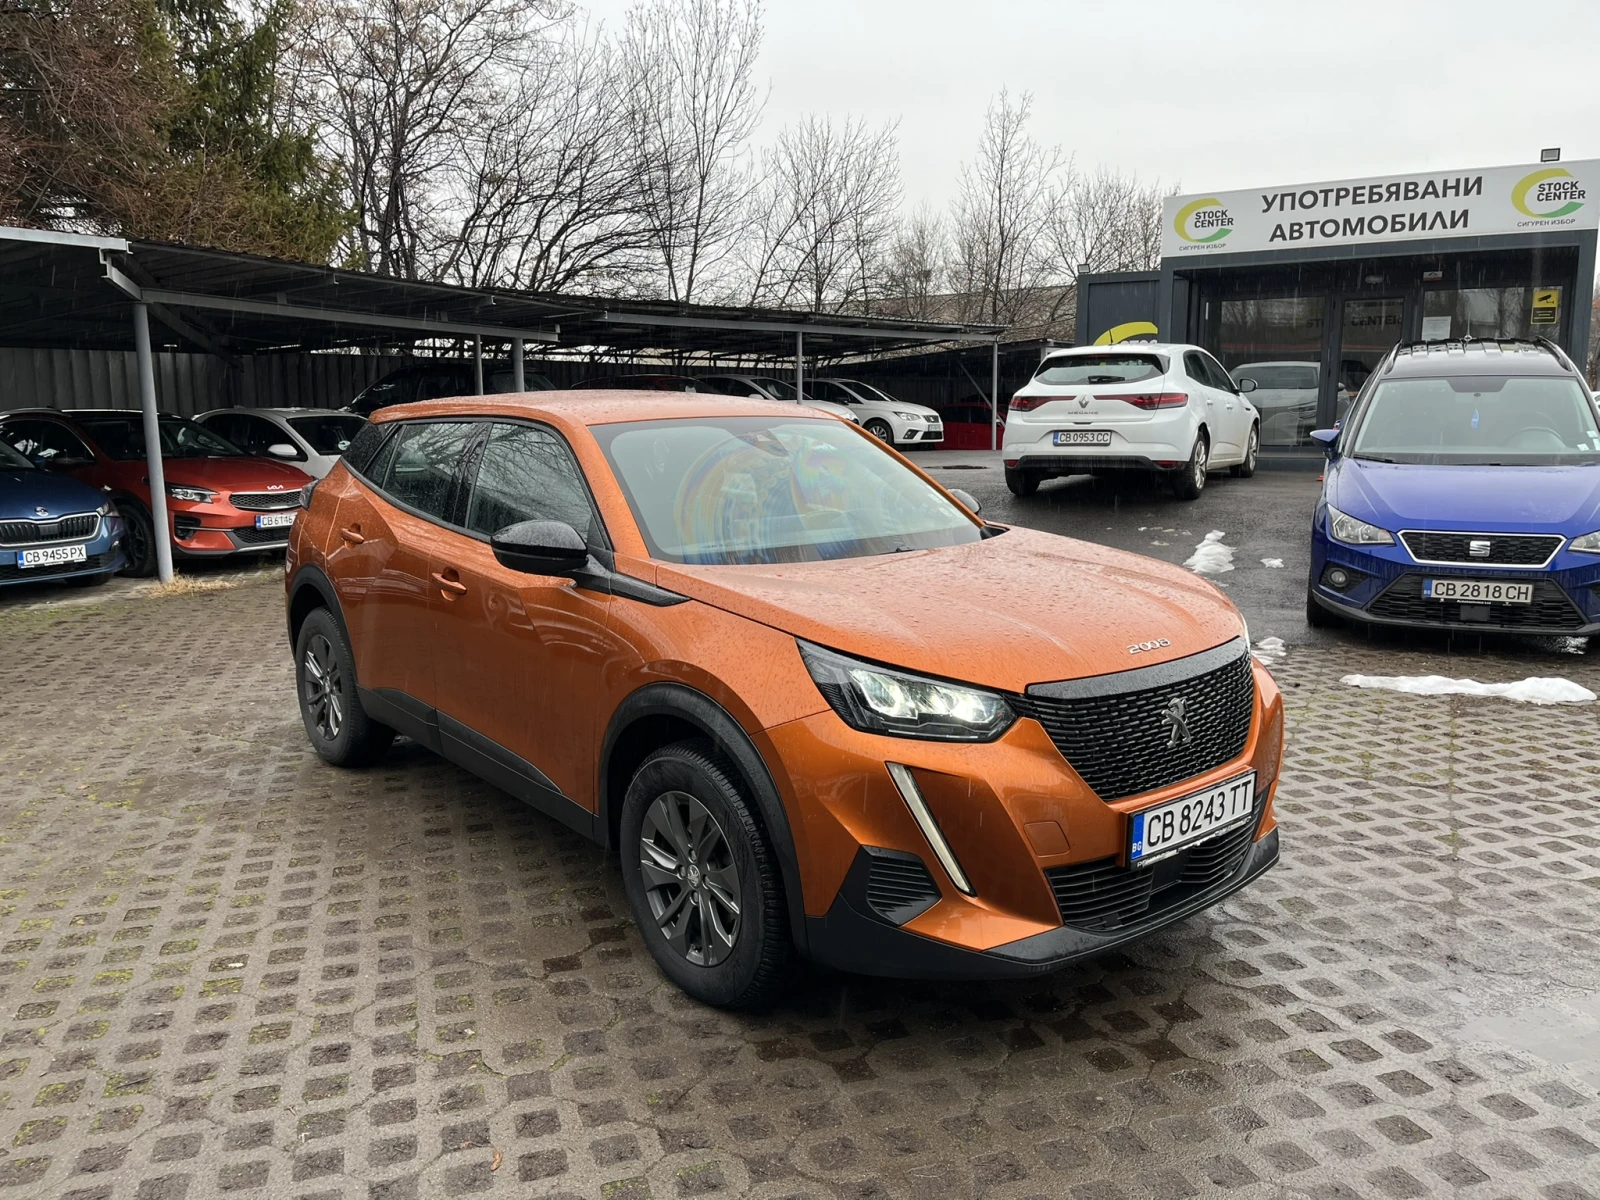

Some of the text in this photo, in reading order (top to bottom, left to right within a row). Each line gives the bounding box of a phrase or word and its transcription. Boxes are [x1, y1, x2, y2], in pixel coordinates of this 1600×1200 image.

[1538, 180, 1579, 193] STOCK
[1261, 176, 1483, 214] УПОТРЕБЯВАНИ
[1536, 189, 1586, 202] CENTER
[1195, 209, 1229, 220] STOCK
[1194, 217, 1234, 229] CENTER
[1268, 209, 1470, 242] АВТОМОБИЛИ
[1517, 218, 1576, 227] СИГУРЕН ИЗБОР
[1059, 432, 1109, 443] CB 0953 CC
[262, 516, 273, 526] CB
[25, 551, 40, 563] CB
[42, 548, 69, 561] 9455
[70, 546, 84, 558] PX
[1434, 582, 1529, 600] CB 2818 CH
[1126, 637, 1171, 655] 2008
[1147, 809, 1175, 847] CB
[1179, 790, 1226, 836] 8243
[1230, 779, 1252, 815] TT
[1131, 841, 1142, 853] BG
